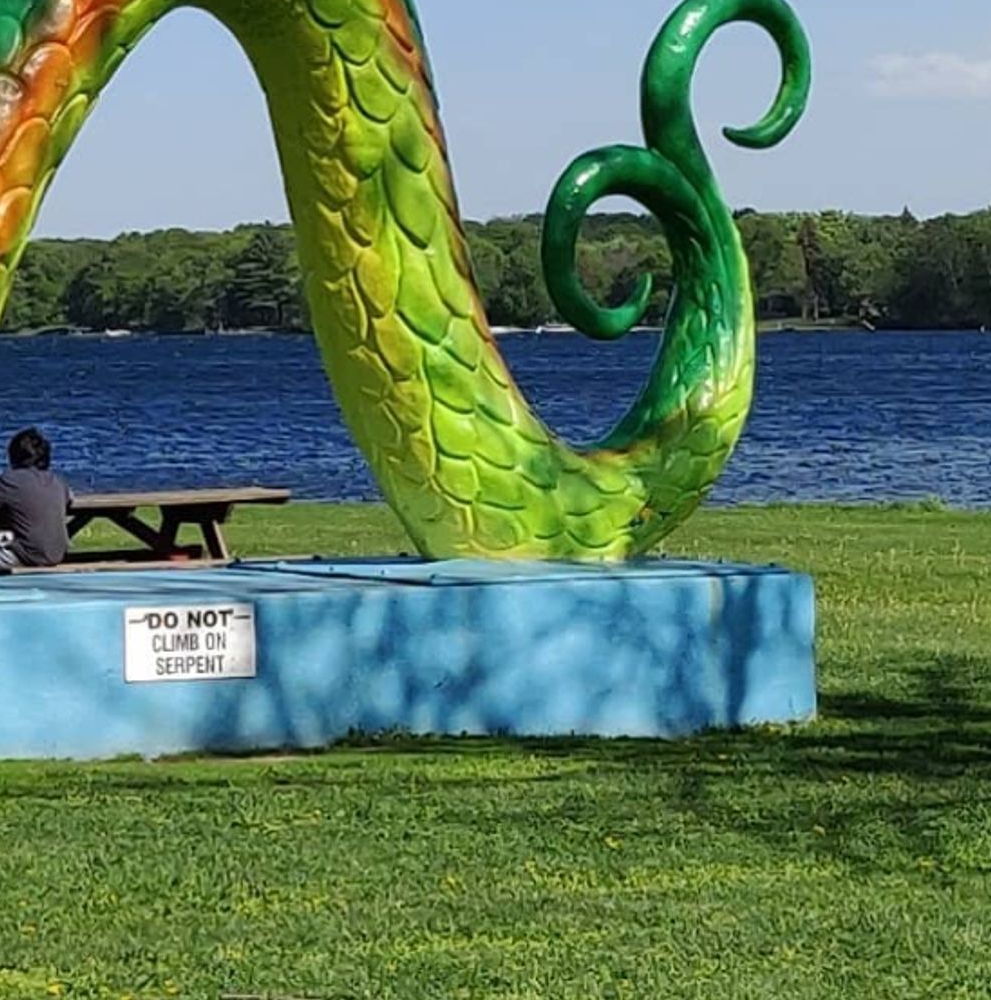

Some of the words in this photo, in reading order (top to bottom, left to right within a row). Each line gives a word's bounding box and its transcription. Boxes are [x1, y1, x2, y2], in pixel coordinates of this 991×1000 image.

[147, 611, 178, 629] DO
[187, 608, 234, 628] NOT
[152, 633, 199, 652] CLIMB
[205, 631, 227, 650] ON
[155, 655, 225, 675] SERPENT
